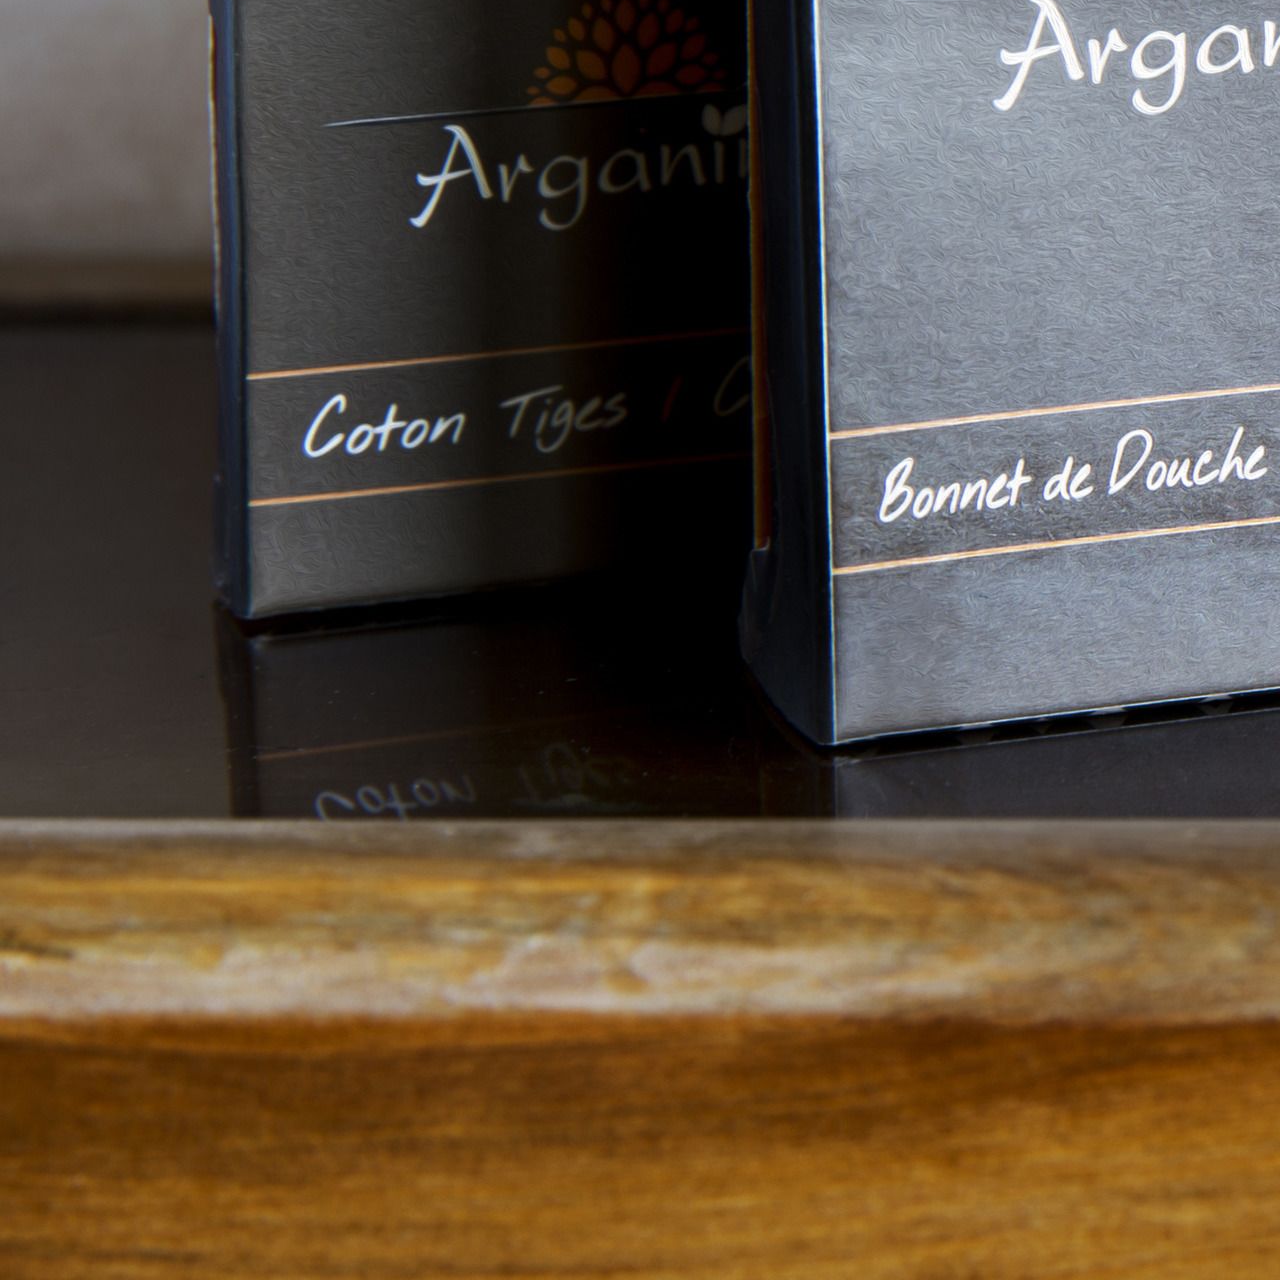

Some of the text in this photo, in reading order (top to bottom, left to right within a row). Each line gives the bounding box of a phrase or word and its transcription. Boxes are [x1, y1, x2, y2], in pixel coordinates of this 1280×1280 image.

[409, 104, 750, 231] Argani
[303, 393, 468, 459] Coton
[500, 384, 630, 454] Tiges
[878, 457, 1031, 523] Bonnet
[1043, 454, 1094, 502] de
[1106, 427, 1265, 497] Douche
